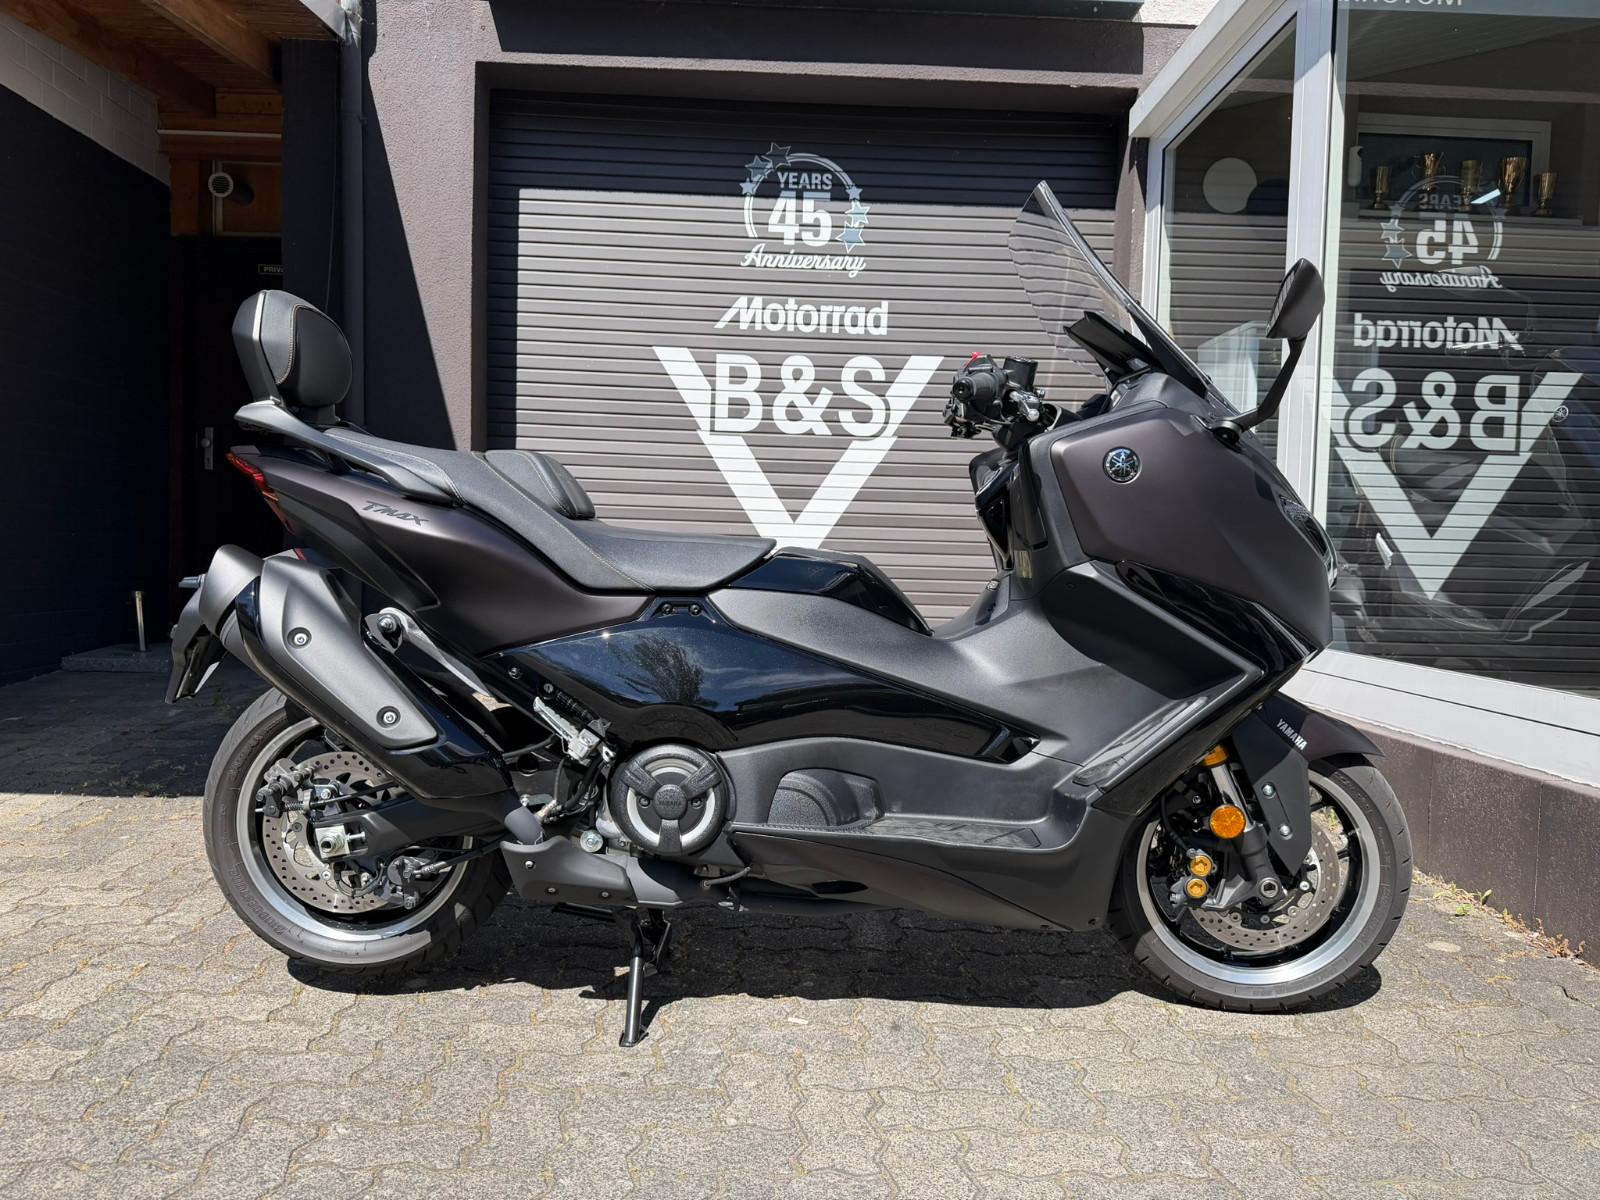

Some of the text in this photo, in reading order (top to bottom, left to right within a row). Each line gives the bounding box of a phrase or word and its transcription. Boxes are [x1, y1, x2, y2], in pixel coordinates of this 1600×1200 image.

[777, 171, 833, 190] YEARS
[768, 190, 832, 247] 45
[740, 243, 867, 278] Anniversary
[714, 296, 889, 335] Motorrad
[714, 353, 886, 437] B&S
[1276, 718, 1308, 750] YAMAHA
